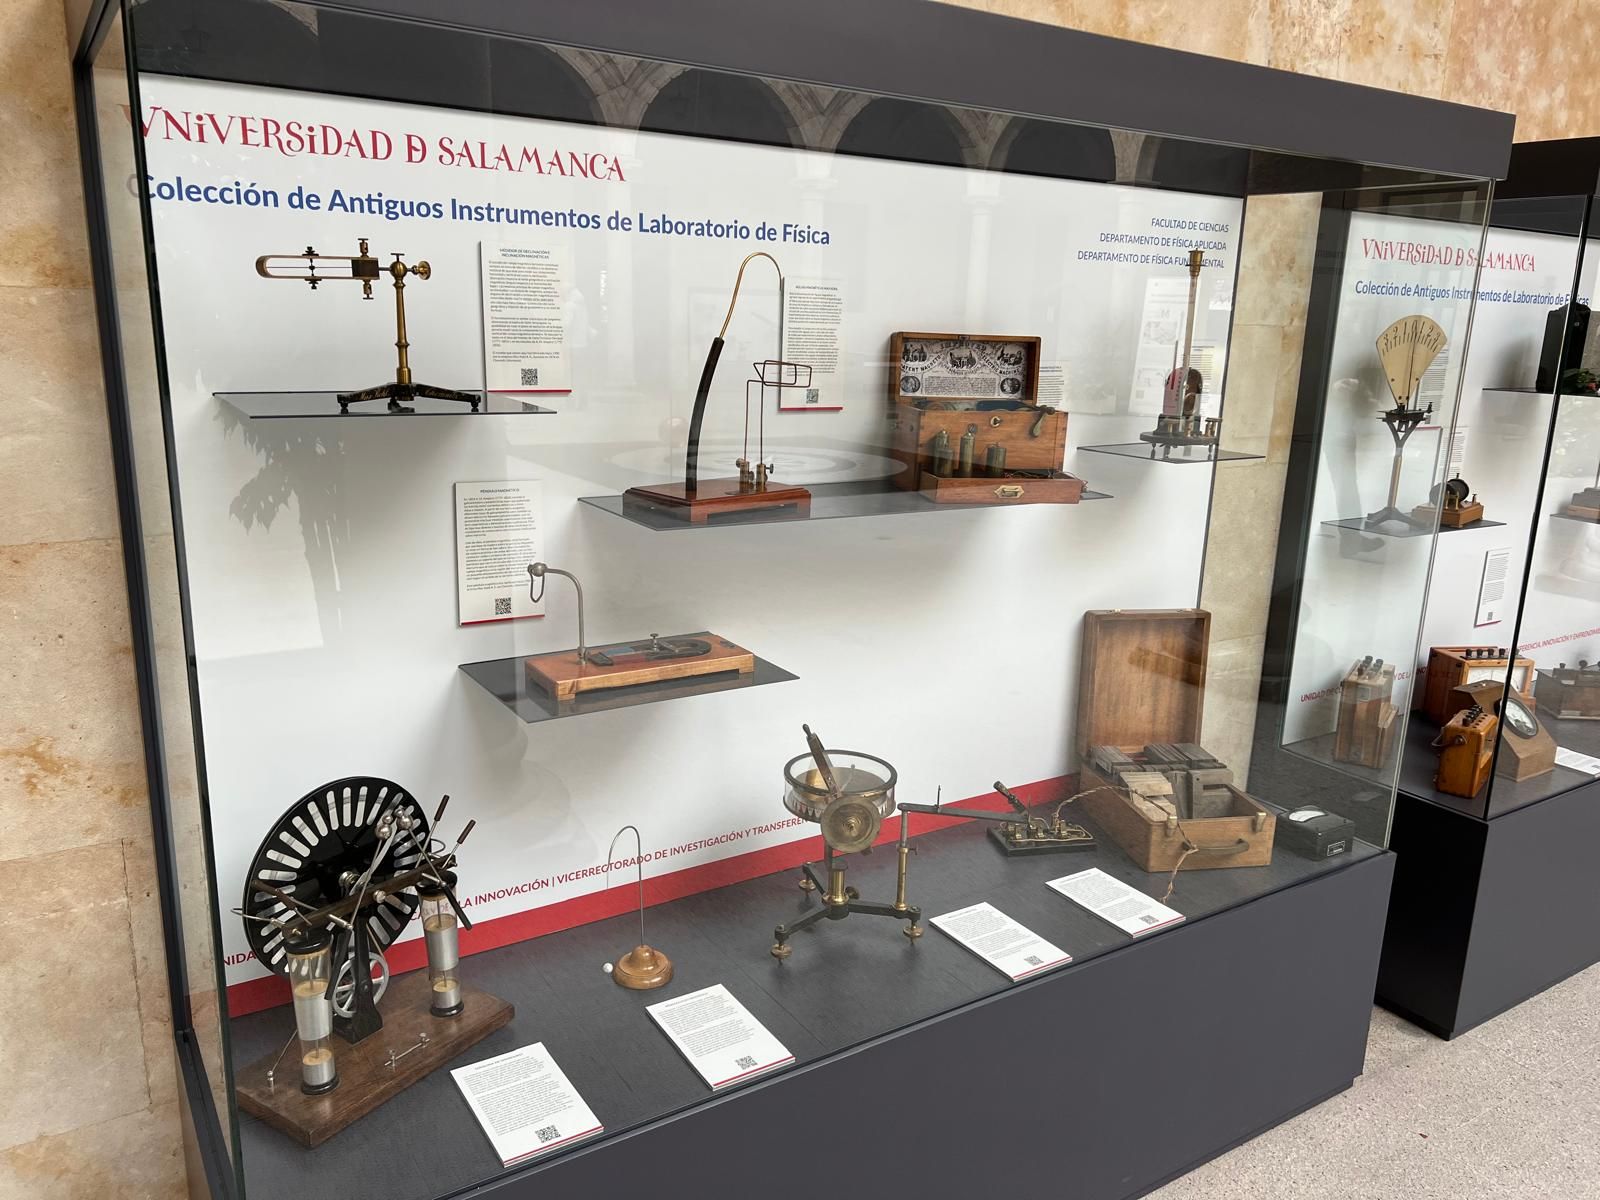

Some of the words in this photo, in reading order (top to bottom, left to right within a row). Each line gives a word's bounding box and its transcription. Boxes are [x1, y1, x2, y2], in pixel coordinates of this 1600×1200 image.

[438, 136, 626, 182] SALAMANCA
[287, 186, 321, 209] de
[328, 188, 444, 221] Antiguos
[451, 198, 601, 231] Instrumentos
[606, 210, 633, 232] de
[638, 212, 750, 241] Laboratorio
[755, 222, 777, 242] de
[782, 223, 831, 246] Física
[1151, 217, 1187, 230] FACULTAD
[1187, 221, 1198, 231] DE
[1198, 222, 1230, 233] CIENCIAS
[1099, 232, 1160, 246] DEPARTAMENTO
[1160, 236, 1173, 247] DE
[1172, 236, 1194, 249] FÍSICA
[1194, 240, 1227, 251] APLICADA
[1077, 250, 1139, 264] DEPARTAMENTO
[1139, 254, 1151, 265] DE
[1151, 253, 1173, 265] FÍSICA
[1355, 280, 1399, 296] Colección
[1401, 283, 1412, 296] de
[1413, 284, 1450, 301] Antiguos
[1502, 290, 1512, 302] de
[1512, 291, 1554, 305] Laboratorio
[1554, 293, 1564, 305] de
[474, 878, 550, 906] INNOVACIÓN
[556, 853, 652, 885] VICERRECTORADO
[655, 849, 668, 860] DE
[670, 831, 744, 856] INVESTIGACIÓN
[744, 828, 751, 837] Y
